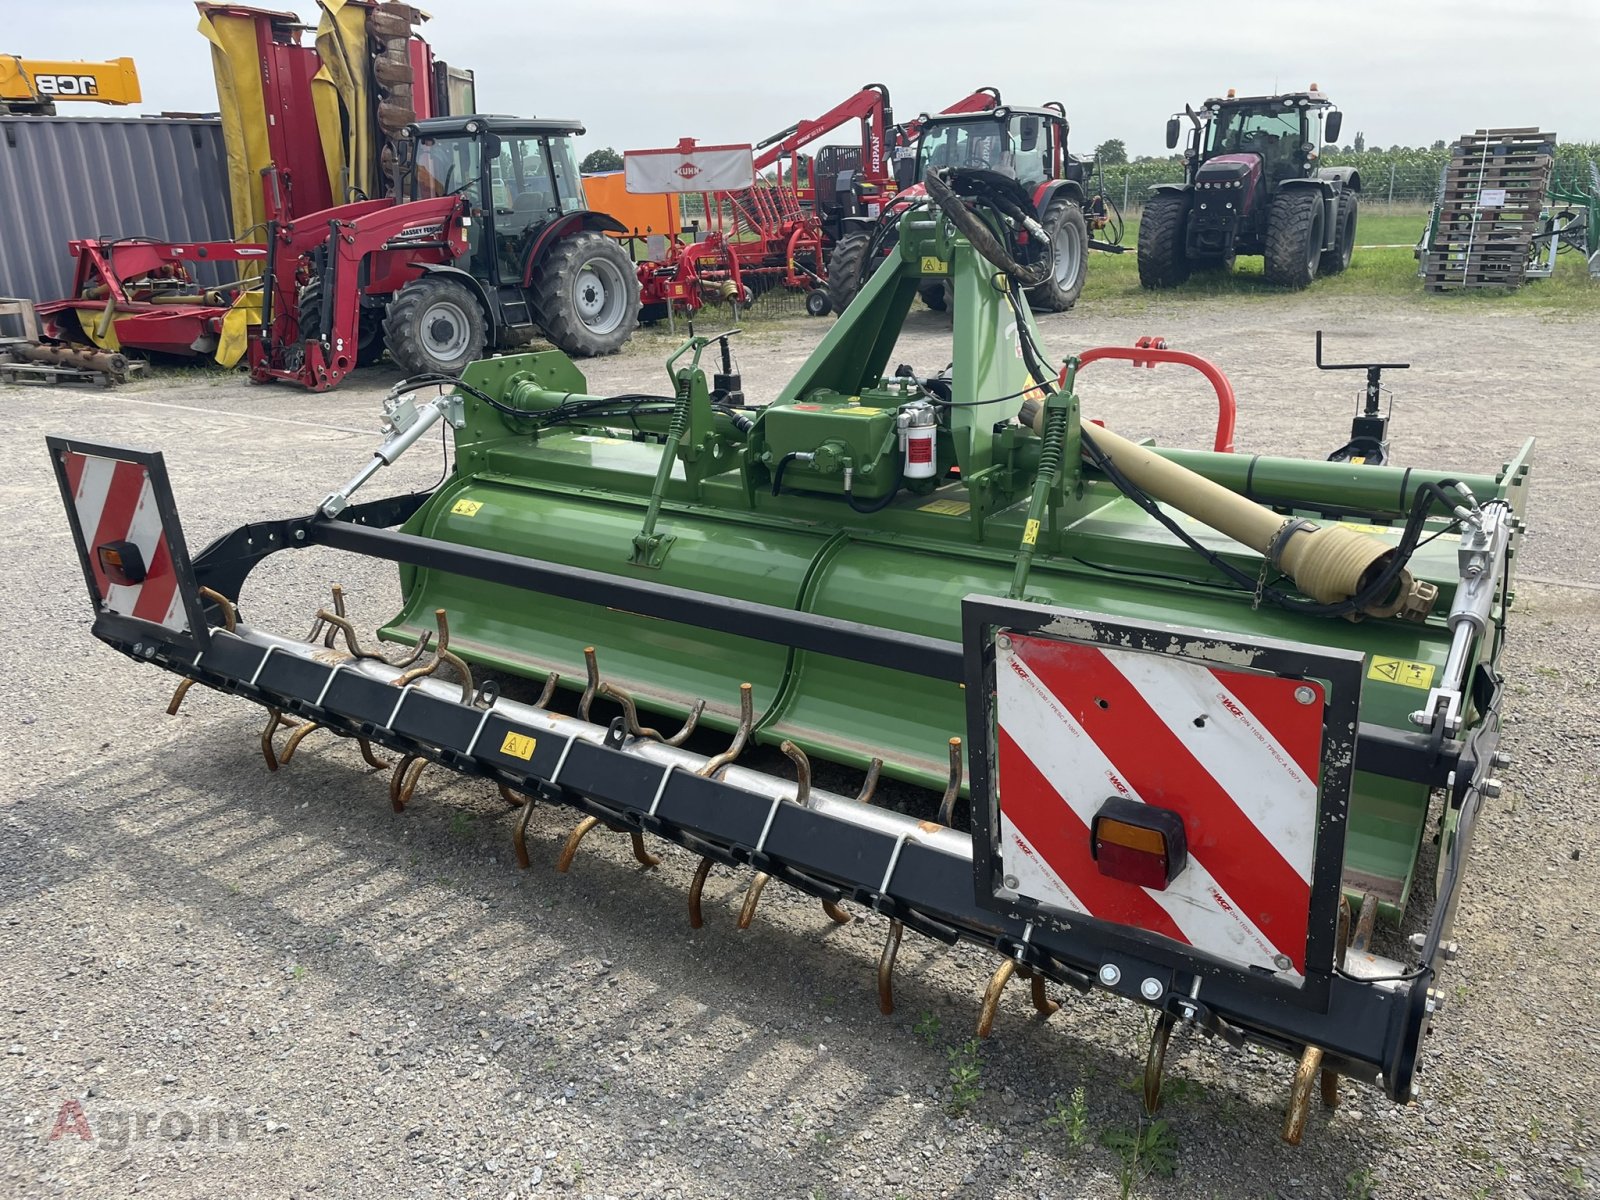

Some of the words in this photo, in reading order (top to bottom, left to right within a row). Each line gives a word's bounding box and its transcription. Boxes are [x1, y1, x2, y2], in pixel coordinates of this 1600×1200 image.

[35, 75, 96, 94] JCB
[872, 136, 880, 173] KRPAN
[677, 167, 700, 175] KUHN
[1011, 660, 1030, 681] WGF
[1026, 678, 1036, 689] DIN
[1034, 687, 1048, 702] 11030
[1221, 698, 1244, 719] WGF
[1239, 715, 1251, 727] DIN
[1249, 726, 1265, 742] 11030
[1286, 767, 1302, 784] 10071
[1109, 775, 1129, 795] WGF
[1015, 839, 1033, 857] WGF
[1213, 892, 1233, 913] WGF
